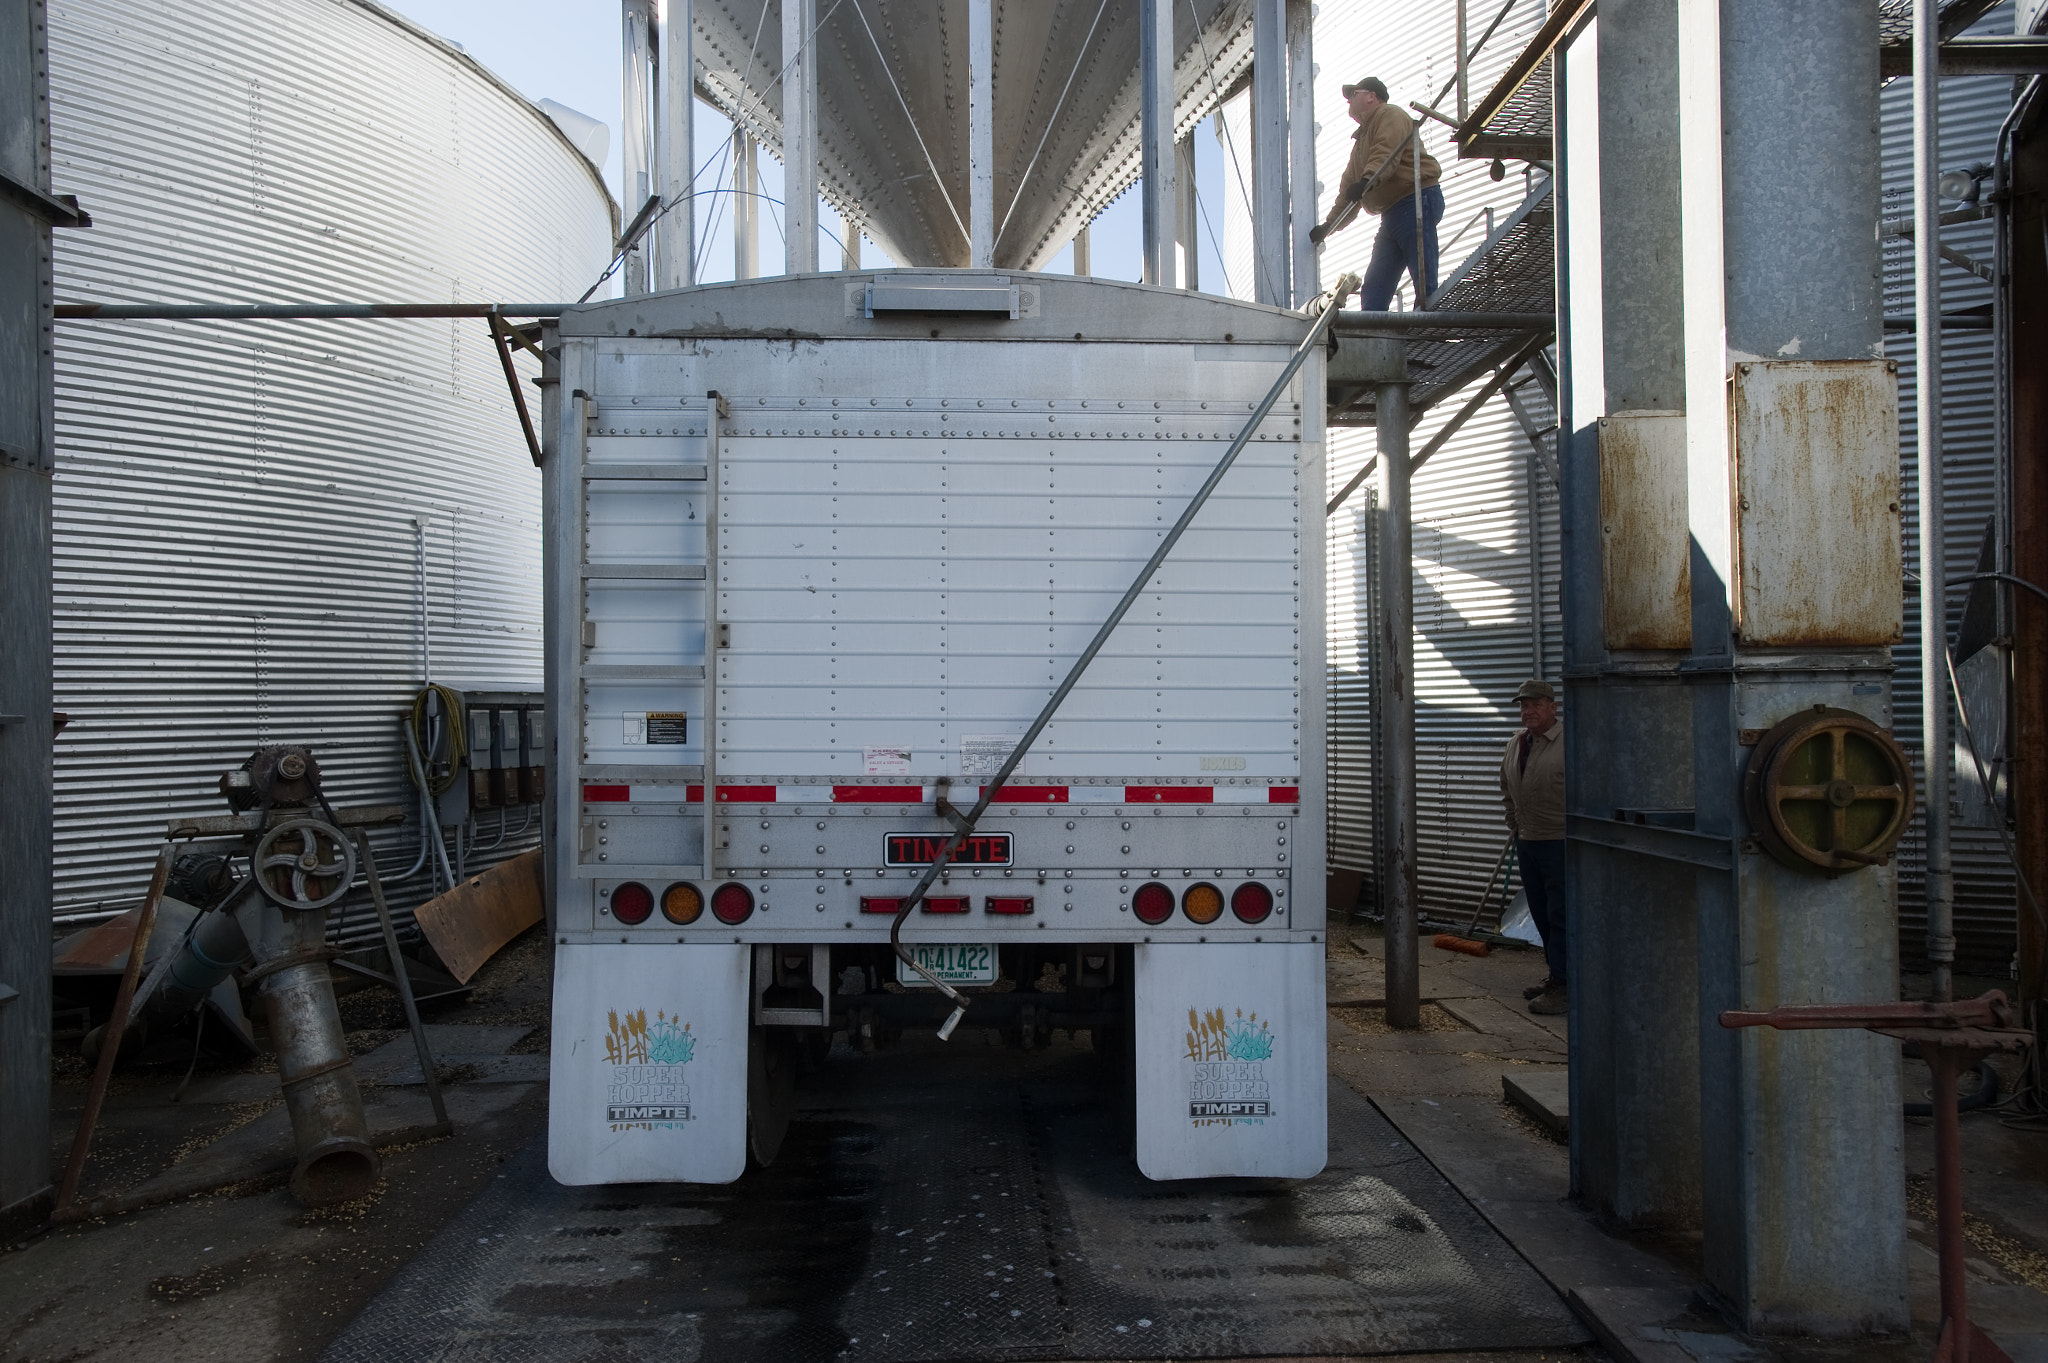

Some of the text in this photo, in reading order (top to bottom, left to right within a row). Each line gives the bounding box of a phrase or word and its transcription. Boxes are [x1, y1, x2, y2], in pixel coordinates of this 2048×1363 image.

[892, 838, 1005, 862] TIMPTE
[937, 971, 973, 979] PERMANENT
[613, 1065, 685, 1085] SUPER
[1194, 1062, 1264, 1081] SUPER
[607, 1084, 691, 1104] HOPPER
[1189, 1081, 1271, 1100] HOPPER
[610, 1106, 687, 1119] TIMPTE
[1192, 1103, 1266, 1115] TIMPTE
